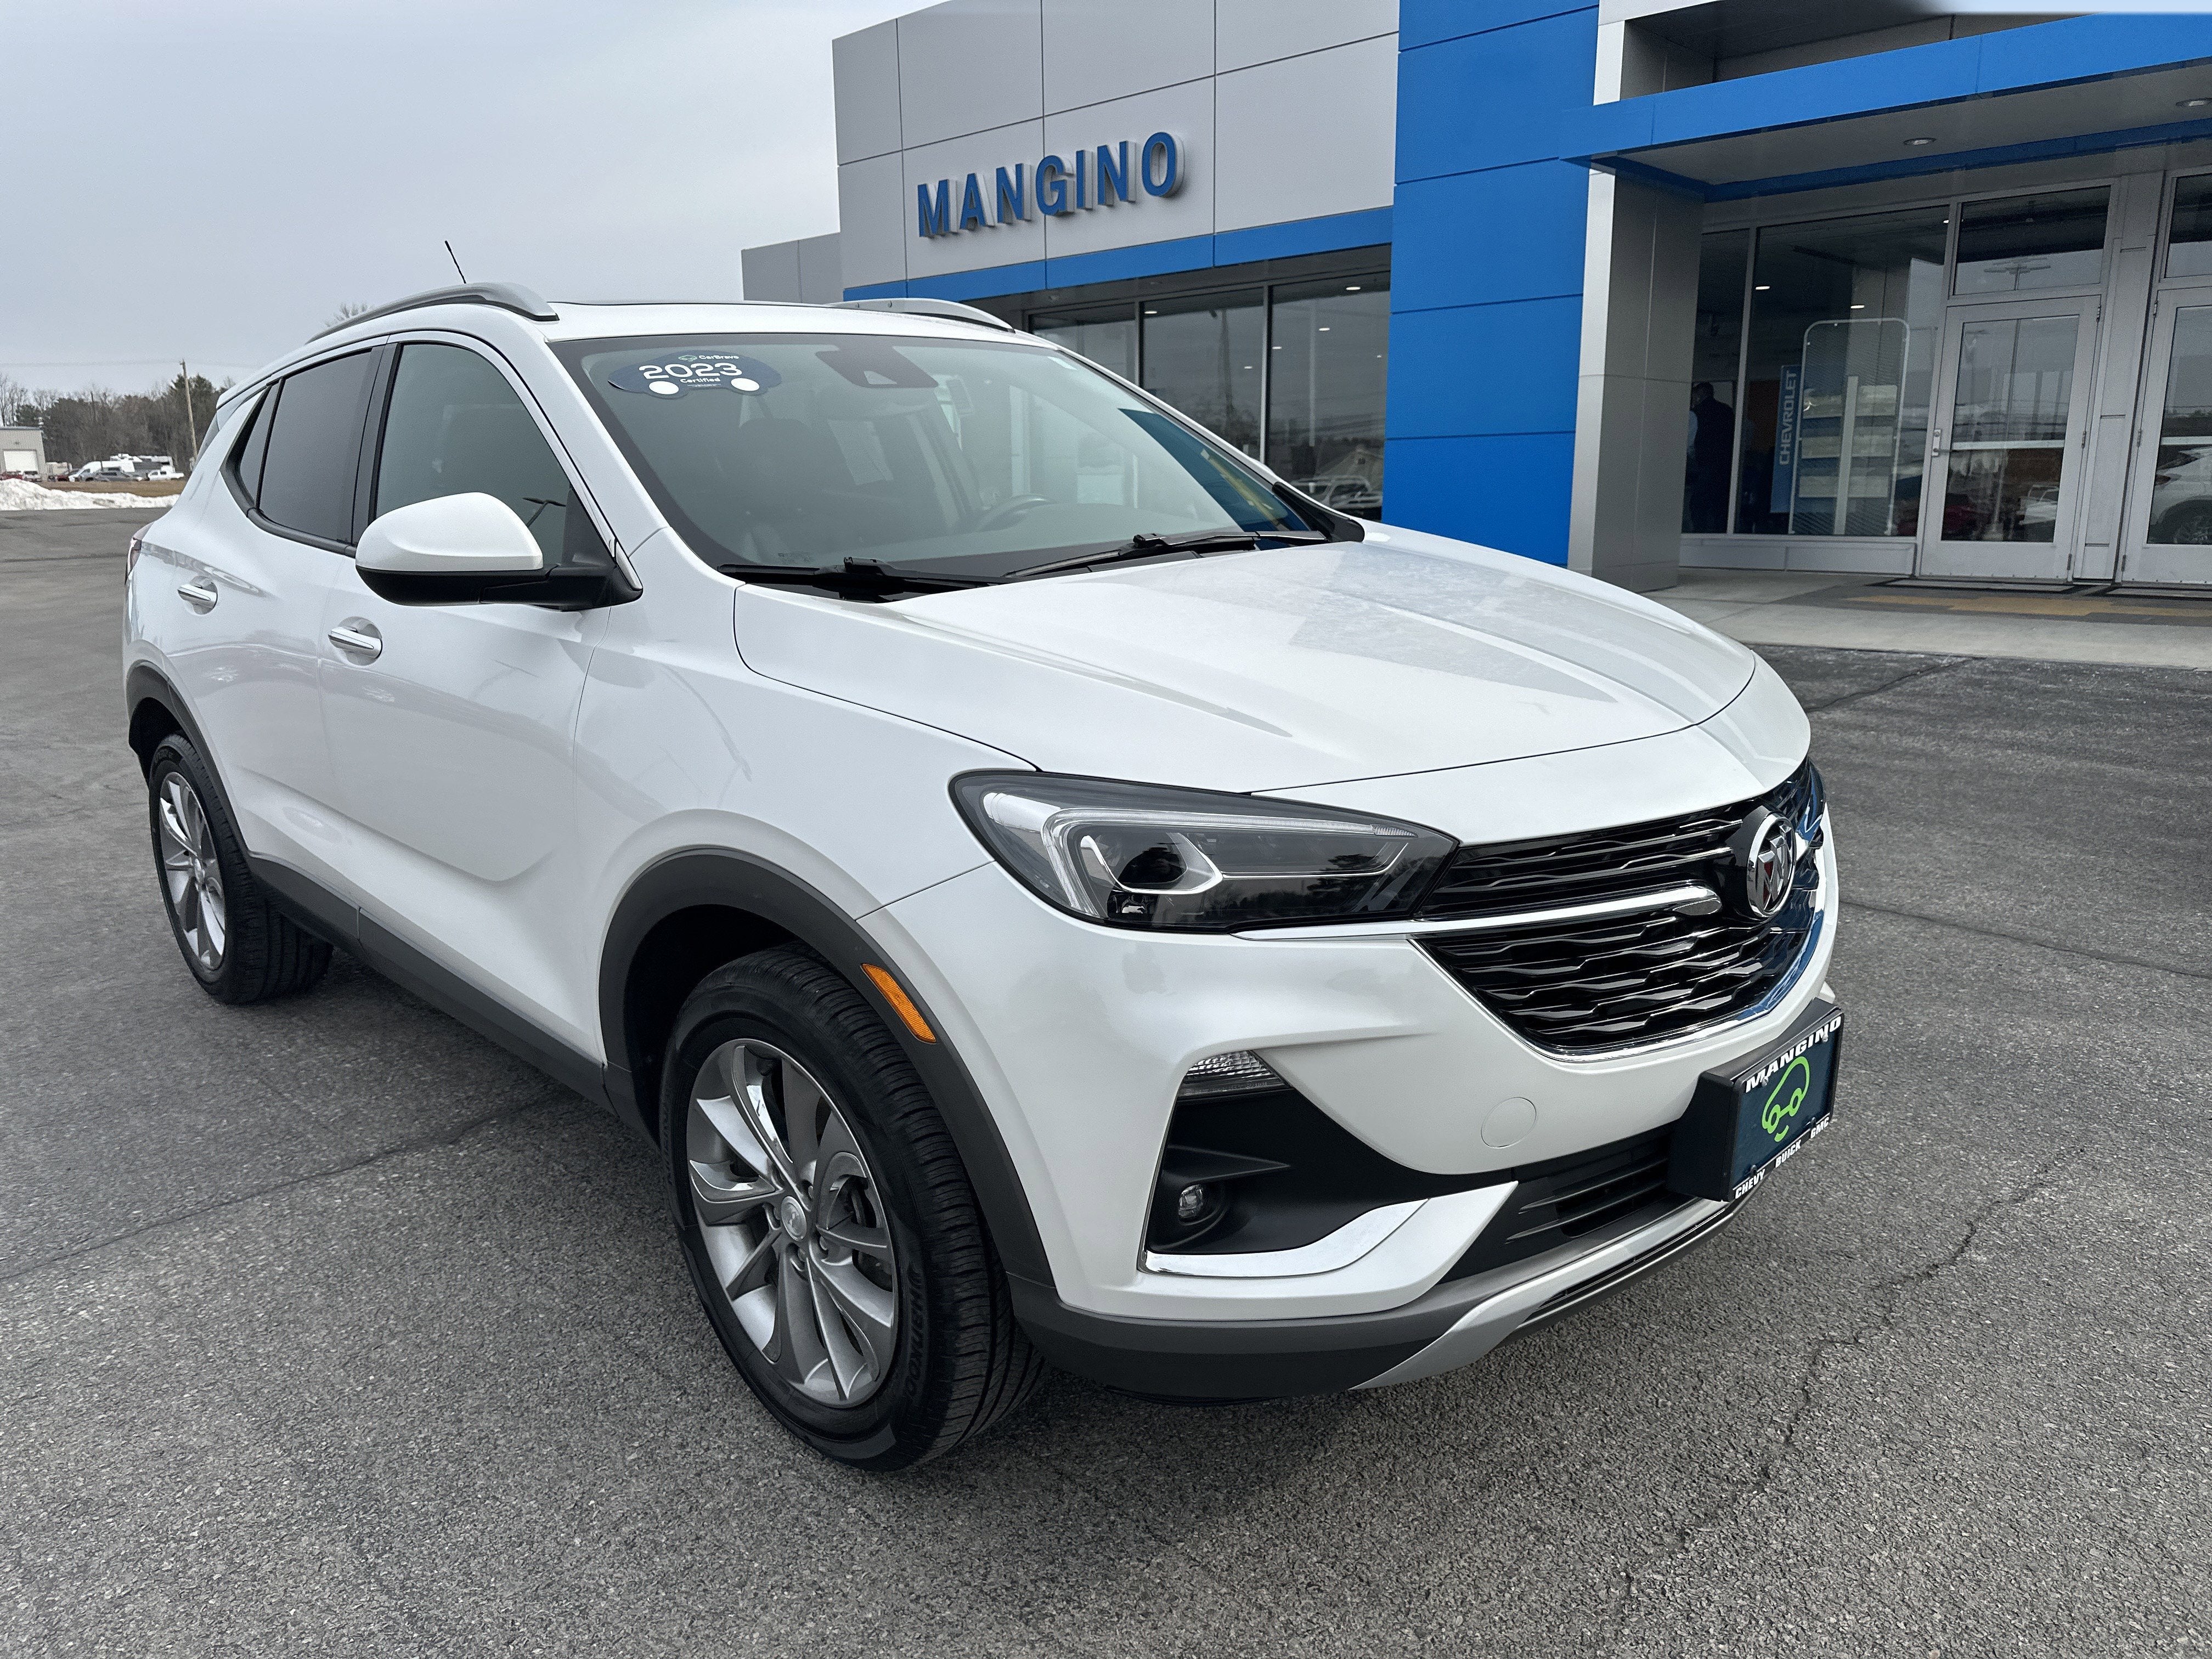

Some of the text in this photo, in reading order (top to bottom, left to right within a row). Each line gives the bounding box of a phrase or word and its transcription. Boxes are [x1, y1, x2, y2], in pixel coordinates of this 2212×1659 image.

[918, 132, 1183, 238] MANGINO
[639, 363, 742, 379] 2023
[1779, 370, 1797, 465] CHEVROLET
[1746, 1016, 1841, 1093] MANGINO
[1735, 1116, 1830, 1199] CHEVY BUICK GMC
